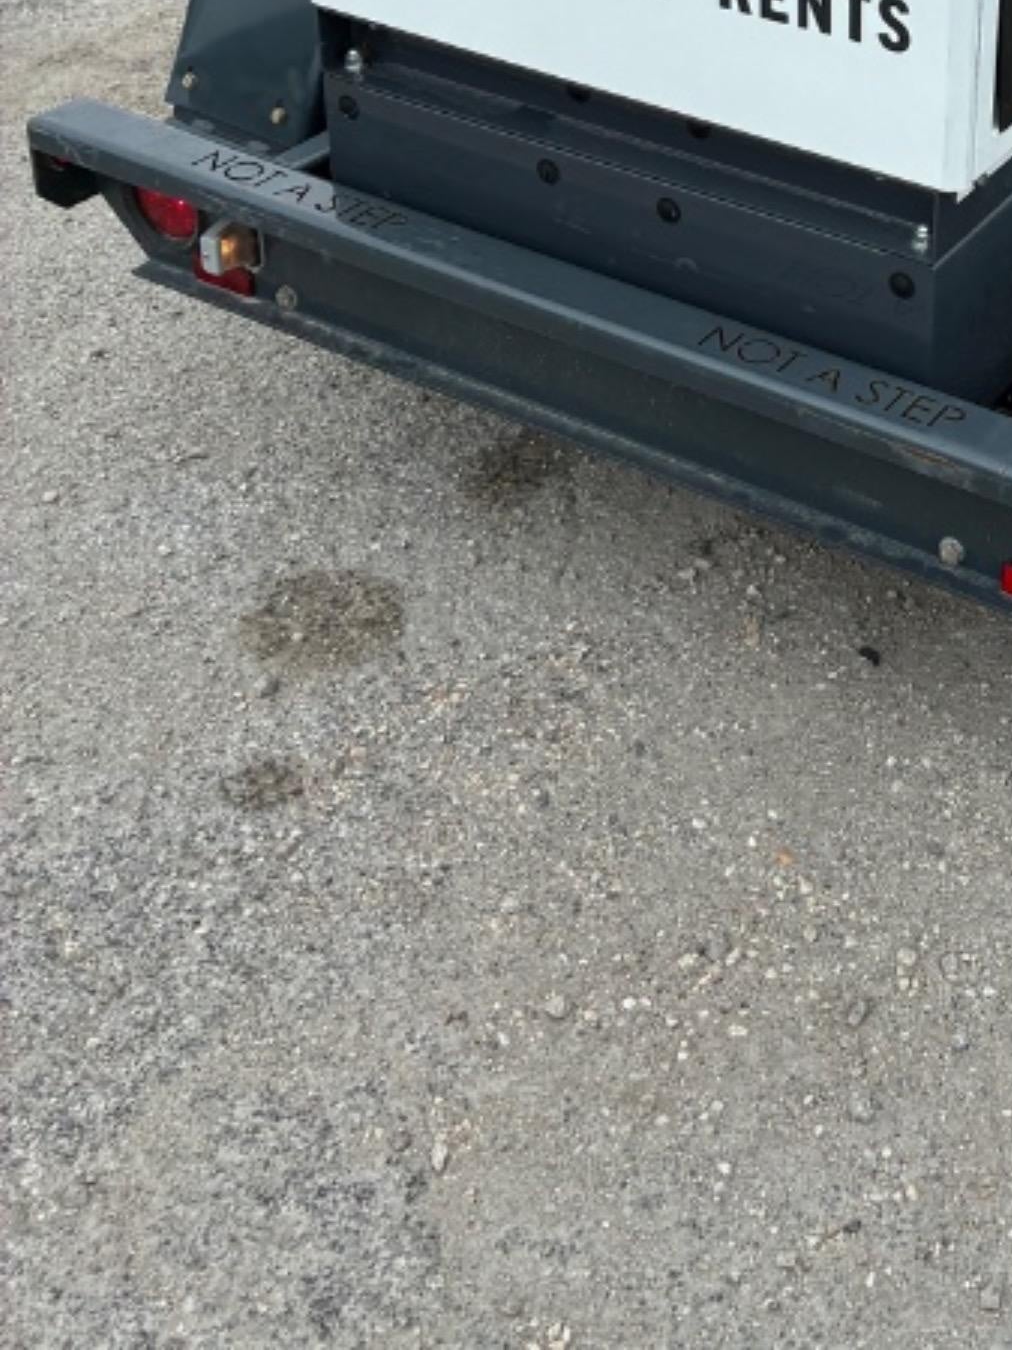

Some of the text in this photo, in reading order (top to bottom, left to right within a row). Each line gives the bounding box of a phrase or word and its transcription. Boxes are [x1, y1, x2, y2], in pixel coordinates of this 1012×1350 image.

[191, 149, 408, 229] NOT A STEP
[697, 325, 967, 438] NOT A STEP
